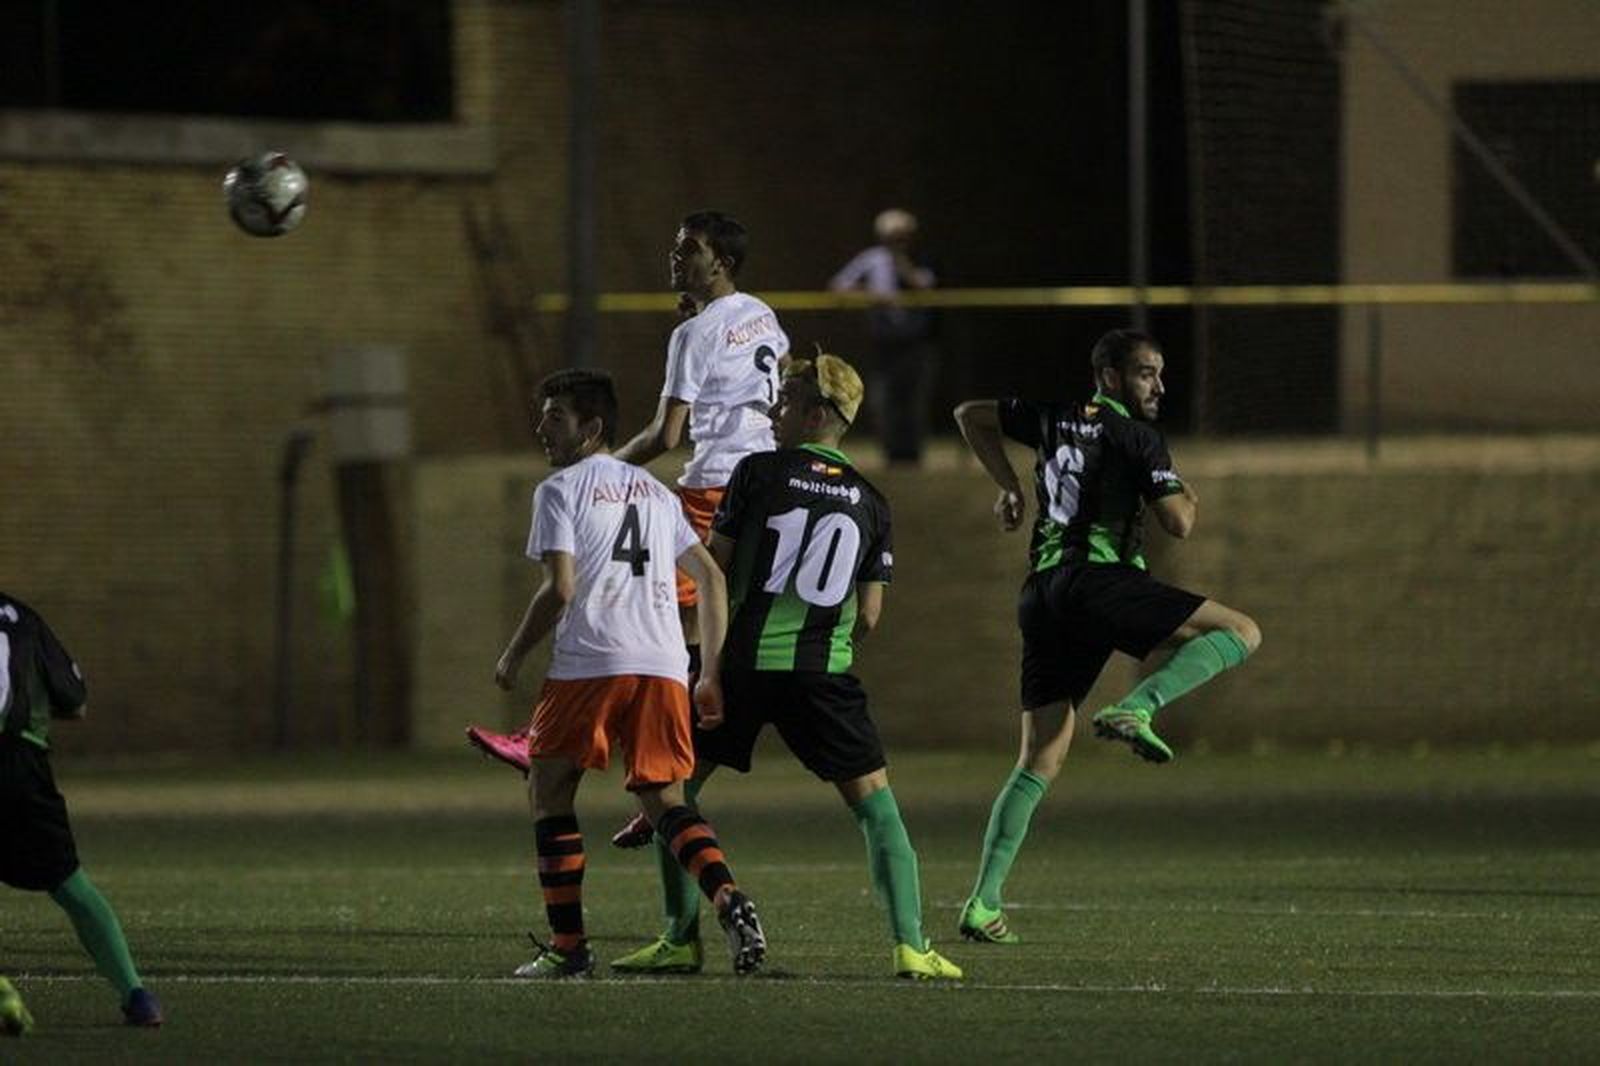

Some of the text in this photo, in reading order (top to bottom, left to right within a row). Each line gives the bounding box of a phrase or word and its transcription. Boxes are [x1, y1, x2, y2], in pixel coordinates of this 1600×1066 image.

[1045, 444, 1085, 525] 6
[611, 503, 650, 577] 4
[763, 506, 860, 607] 10
